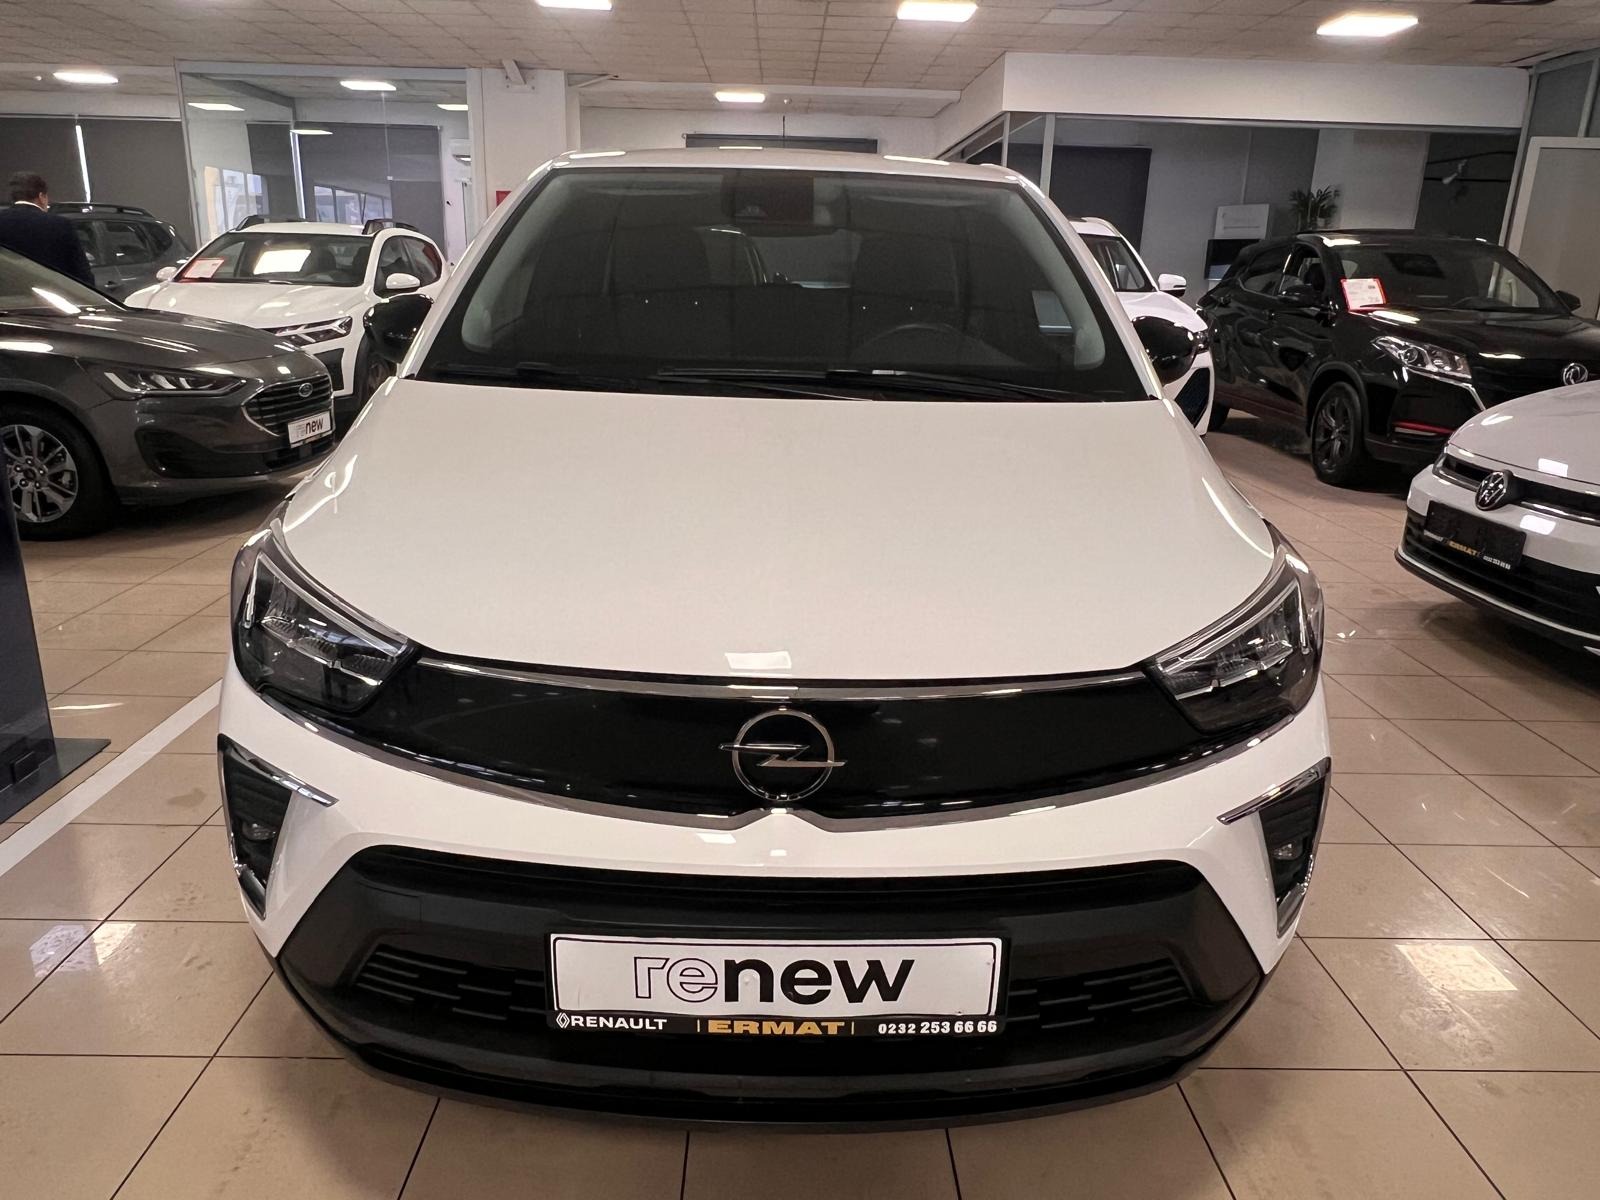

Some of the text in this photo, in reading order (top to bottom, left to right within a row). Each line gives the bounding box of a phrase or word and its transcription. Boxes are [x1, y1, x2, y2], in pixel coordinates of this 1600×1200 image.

[634, 957, 915, 1005] renew
[571, 1015, 667, 1030] RENAULT
[708, 1019, 845, 1035] ERMAT
[878, 1020, 998, 1034] 0232 253 66 66
